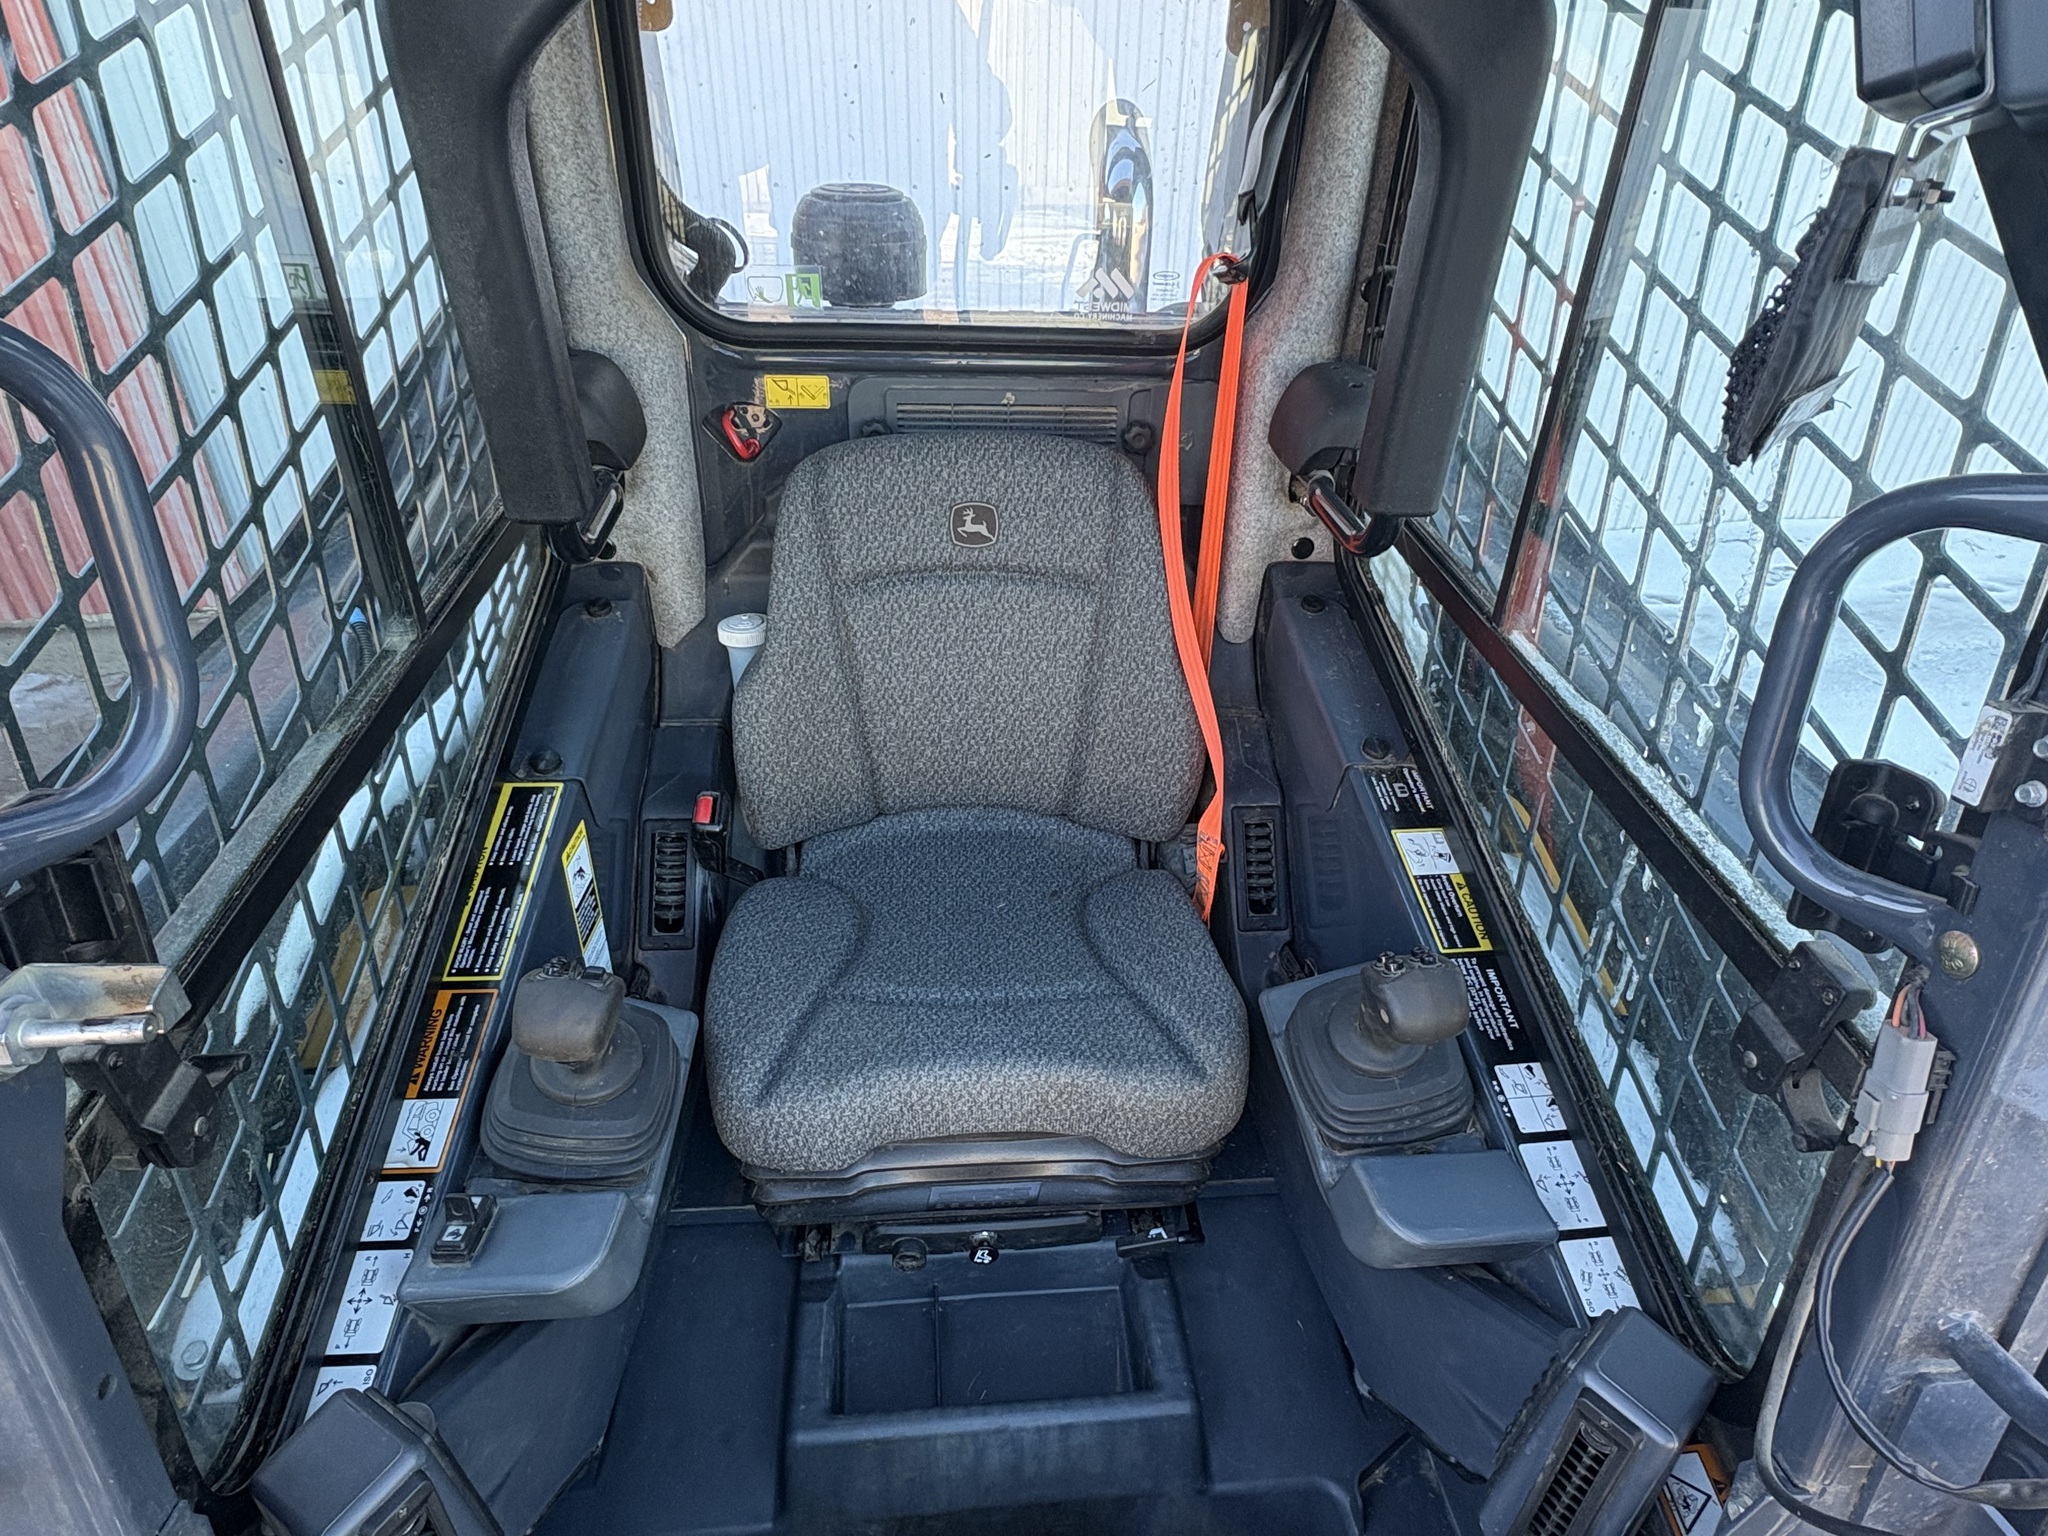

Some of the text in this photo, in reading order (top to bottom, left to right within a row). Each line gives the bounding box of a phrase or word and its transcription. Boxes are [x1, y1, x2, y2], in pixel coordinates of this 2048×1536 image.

[1411, 770, 1434, 809] IMPORTANT
[1441, 875, 1462, 917] Avoid Overturn
[1462, 892, 1489, 939] CAUTION
[1486, 968, 1519, 1029] IMPORTANT
[415, 1009, 442, 1068] WARNING
[1585, 1298, 1595, 1313] ISO
[362, 1368, 374, 1385] ISO
